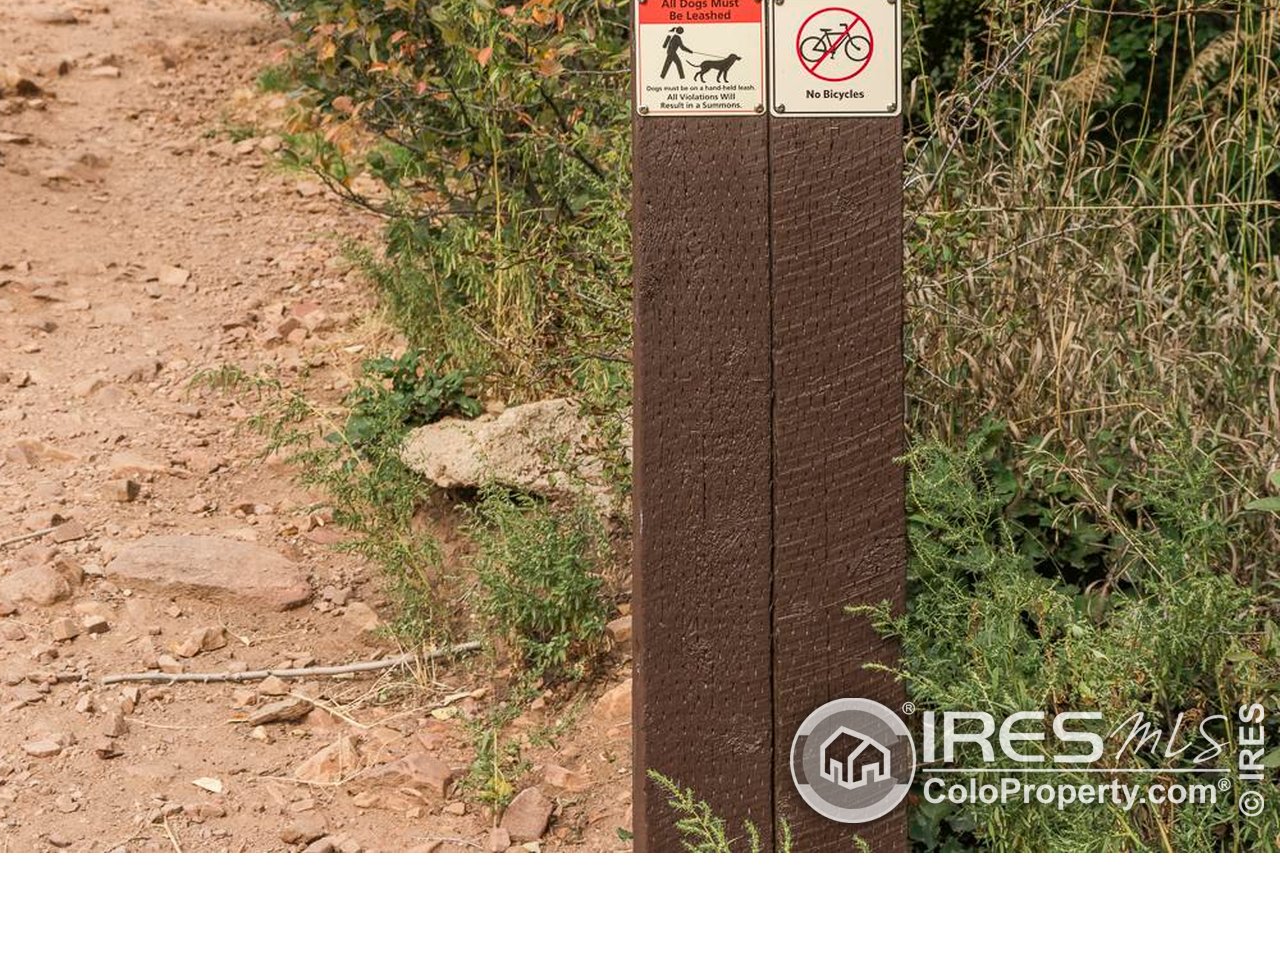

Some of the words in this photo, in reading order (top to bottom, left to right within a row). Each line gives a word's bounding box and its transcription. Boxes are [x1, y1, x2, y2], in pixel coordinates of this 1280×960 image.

[661, 0, 677, 8] All
[679, 0, 708, 10] Dogs
[669, 11, 683, 21] Be
[686, 10, 731, 21] Leashed
[679, 93, 719, 101] Violations
[805, 89, 822, 99] No
[823, 89, 865, 100] Bicycles
[702, 101, 742, 109] Summons.
